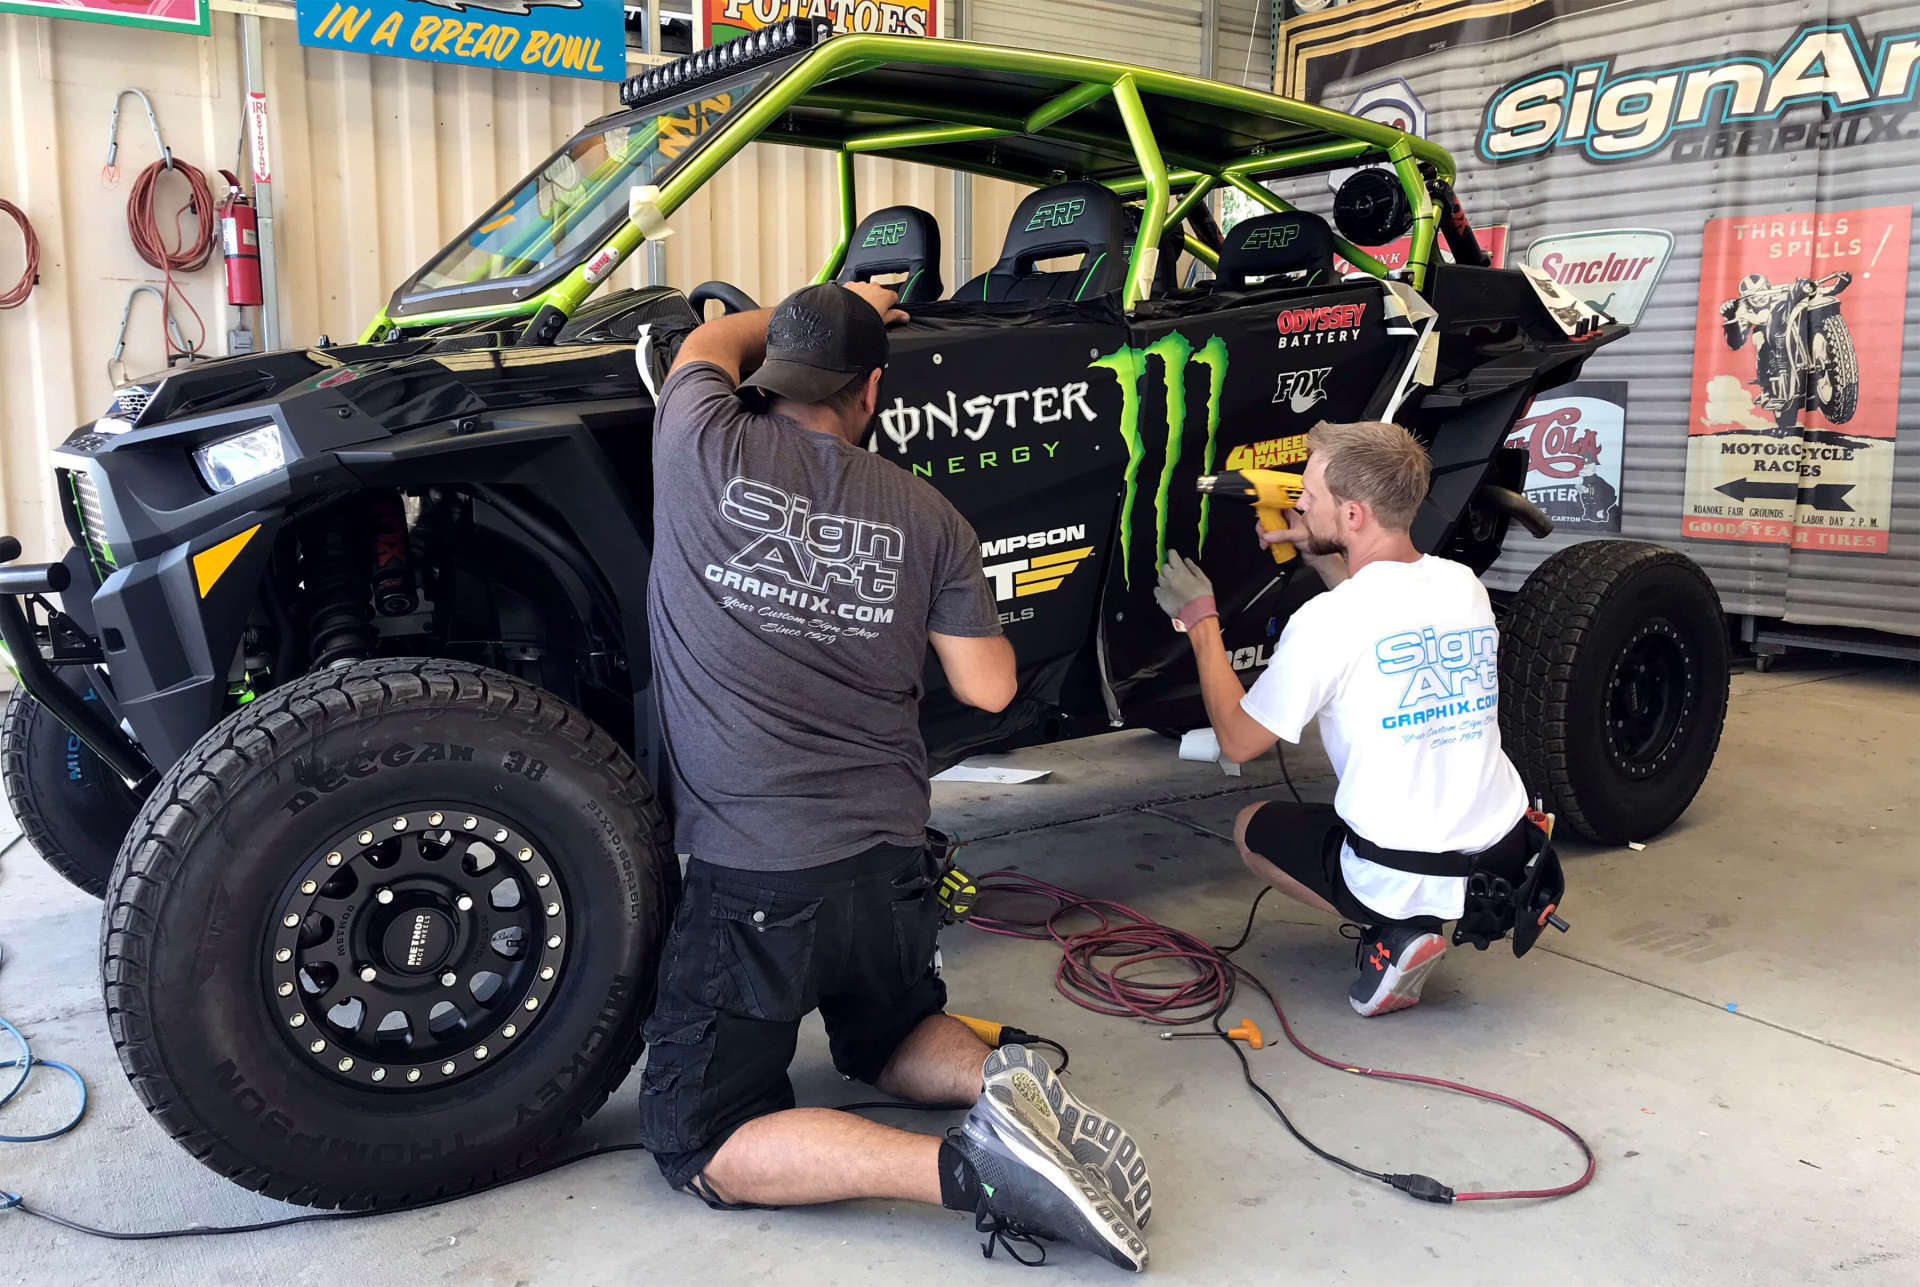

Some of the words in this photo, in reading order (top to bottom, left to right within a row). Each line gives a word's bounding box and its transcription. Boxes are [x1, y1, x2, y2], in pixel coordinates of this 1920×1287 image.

[314, 2, 371, 42] IN
[370, 11, 404, 47] A
[410, 16, 519, 61] BREAD
[521, 30, 603, 72] BOWL
[1025, 199, 1087, 232] PRP
[1734, 218, 1849, 241] THRILLS
[862, 221, 908, 248] PRP
[1241, 224, 1300, 250] PRP
[1542, 251, 1655, 285] Sinclair
[1277, 303, 1367, 334] ODYSSEY
[1278, 329, 1361, 349] BATTERY
[1272, 367, 1333, 413] FOX
[868, 381, 1098, 454] ONSTER
[912, 441, 1060, 478] NERGY
[1226, 444, 1253, 471] 4
[1254, 448, 1308, 470] PARTS
[1721, 442, 1855, 461] MOTORCYCLE
[1754, 459, 1821, 477] RACES
[719, 476, 905, 562] Sign
[1694, 505, 1723, 515] ROANOKE
[1727, 506, 1744, 516] FAIR
[1749, 508, 1784, 518] GROUNDS
[1802, 515, 1824, 525] LABOR
[1829, 517, 1845, 527] DAY
[1850, 517, 1856, 526] 2
[980, 524, 1086, 558] MPSON
[1816, 533, 1877, 547] TIRES
[725, 533, 898, 603] Art
[705, 564, 895, 624] GRAPHIX.COM
[716, 596, 754, 612] Your
[757, 607, 805, 625] Custom
[807, 618, 842, 634] Sign
[841, 627, 880, 641] Shop
[760, 622, 802, 638] Since
[998, 607, 1035, 625] ELS
[1376, 625, 1499, 674] Sign
[1399, 659, 1498, 709] Art
[502, 750, 549, 782] 38
[407, 915, 425, 966] METHOD
